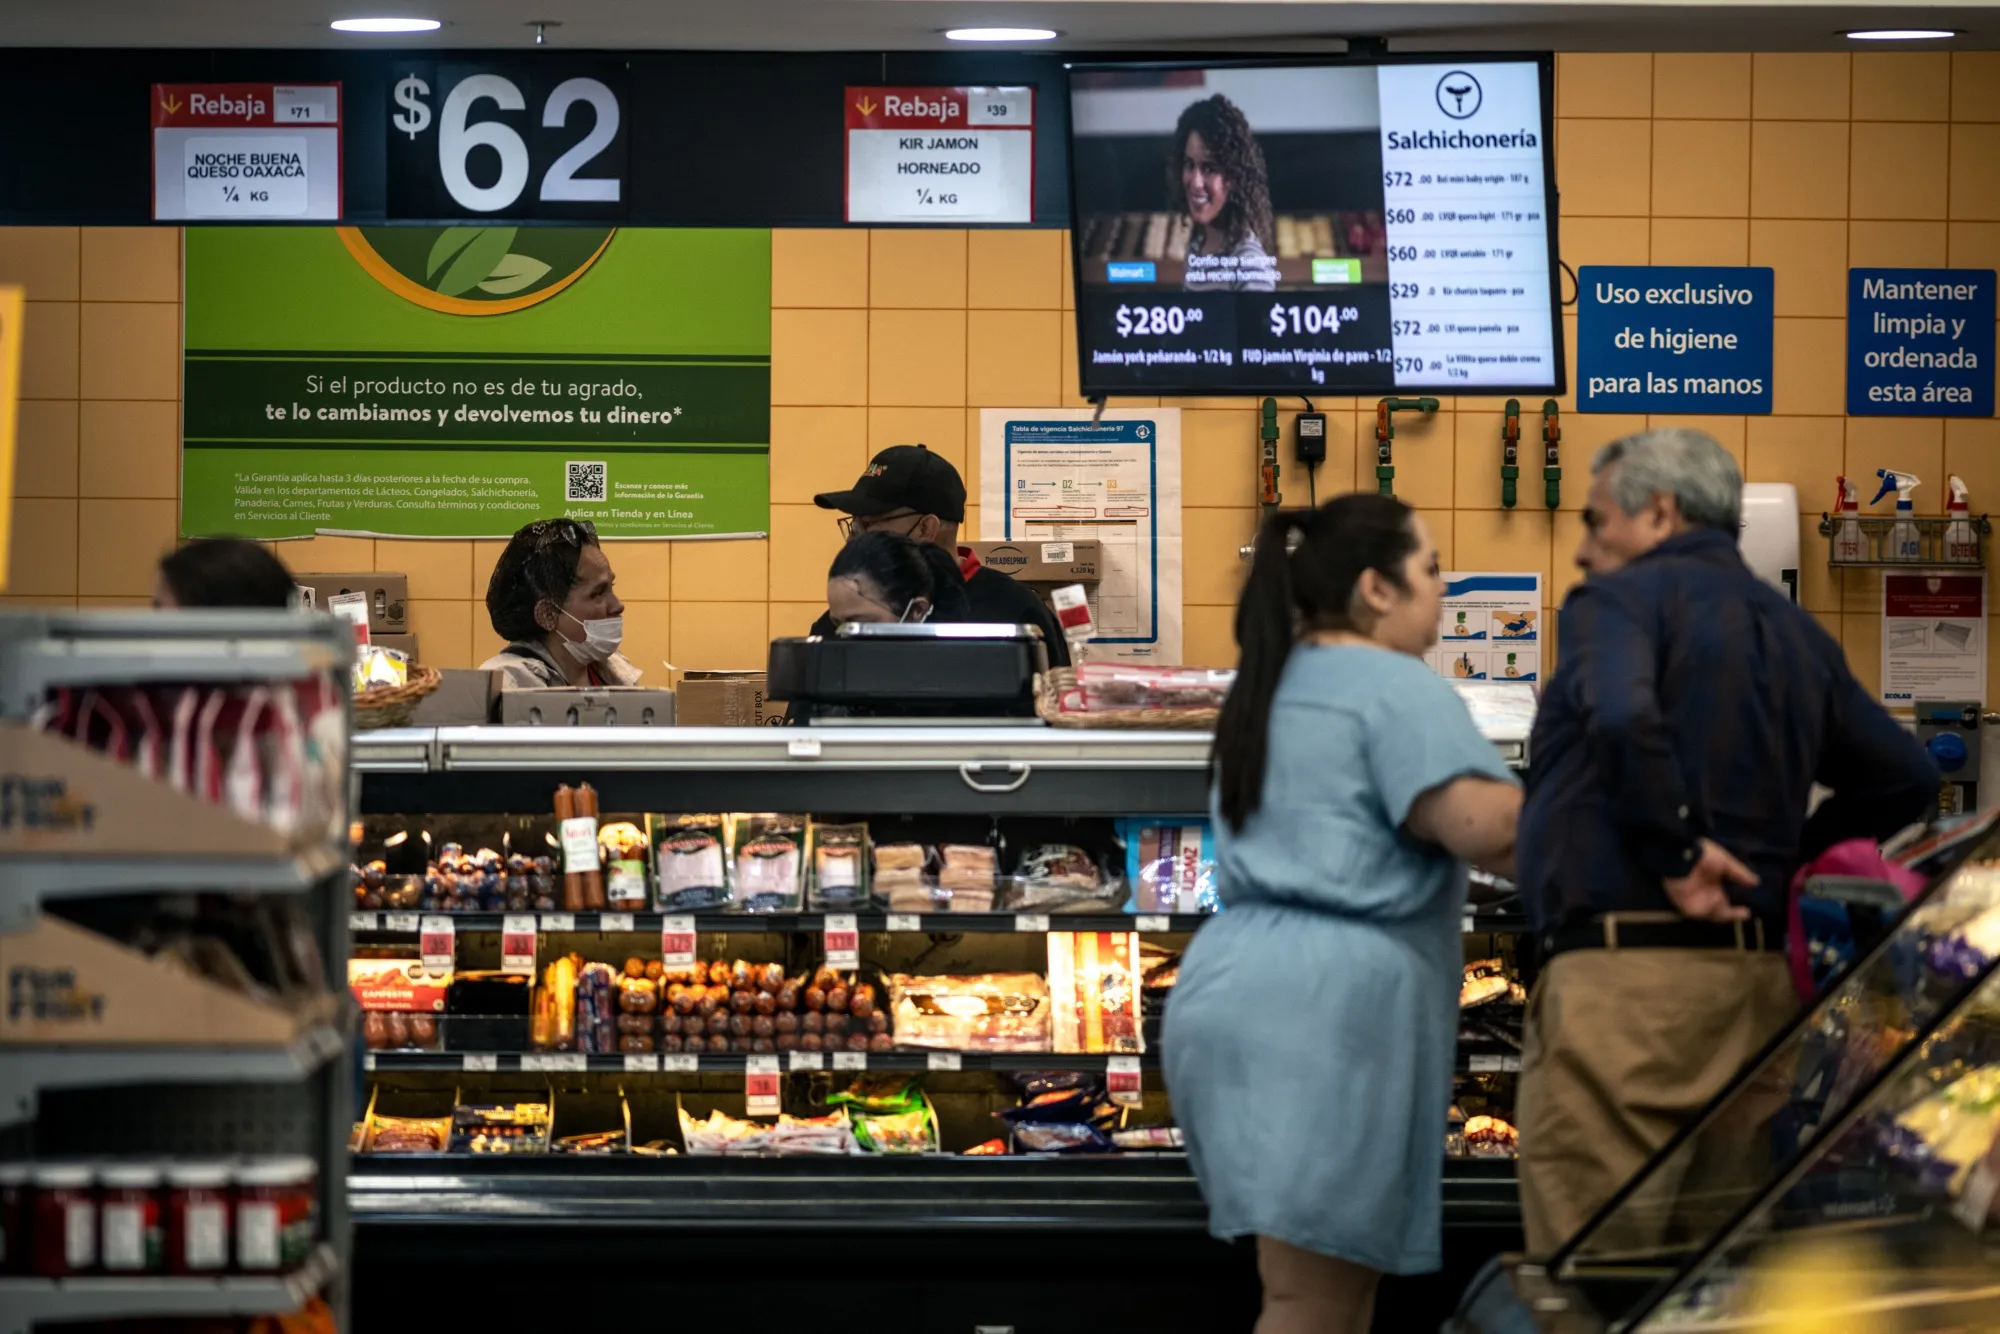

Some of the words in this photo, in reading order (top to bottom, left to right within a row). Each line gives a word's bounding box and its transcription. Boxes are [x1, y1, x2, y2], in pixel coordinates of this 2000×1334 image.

[190, 93, 265, 121] Rebaja
[291, 107, 310, 118] $71
[884, 95, 960, 123] Rebaja
[987, 105, 1007, 116] $39
[393, 73, 620, 212] $62
[899, 137, 923, 149] KIR
[927, 137, 979, 150] JAMON
[1388, 128, 1537, 150] Salchichonería
[195, 153, 246, 166] NOCHE
[250, 153, 301, 165] BUENA
[187, 166, 239, 179] QUESO
[243, 165, 305, 178] OAXACA
[897, 162, 981, 174] HORNEADO
[1385, 171, 1413, 188] $72
[250, 191, 269, 202] KG
[939, 194, 958, 204] KG
[1387, 208, 1415, 225] $60
[1389, 245, 1417, 262] $60
[1390, 283, 1419, 299] $29
[1596, 283, 1640, 304] Uso
[1644, 283, 1753, 305] exclusivo
[1862, 278, 1978, 301] Mantener
[1393, 320, 1421, 337] $72
[1873, 312, 1946, 338] limpia
[1951, 318, 1966, 340] y
[1614, 328, 1644, 349] de
[1650, 328, 1738, 354] higiene
[1093, 350, 1123, 363] Jamón
[1124, 350, 1146, 365] york
[1146, 350, 1196, 365] peñaranda
[1203, 350, 1219, 363] 1/2
[1220, 350, 1232, 366] kg
[1294, 349, 1331, 365] Virginia
[1332, 350, 1345, 363] de
[1346, 350, 1369, 365] pavo
[1376, 350, 1392, 362] 1/2
[1864, 347, 1978, 369] ordenada
[1395, 357, 1423, 374] $70
[1311, 367, 1324, 384] kg
[306, 375, 324, 394] Si
[330, 375, 346, 394] el
[354, 375, 446, 398] producto
[453, 380, 477, 395] no
[484, 380, 505, 396] es
[511, 376, 536, 396] de
[542, 379, 563, 396] tu
[568, 377, 643, 401] agrado,
[1589, 376, 1640, 398] para
[1647, 372, 1678, 394] las
[1683, 376, 1763, 395] manos
[1868, 383, 1917, 402] esta
[1922, 381, 1972, 403] área
[266, 405, 287, 420] te
[292, 403, 311, 420] lo
[316, 403, 432, 422] cambiamos
[437, 409, 450, 427] y
[454, 404, 574, 424] devolvemos
[580, 407, 601, 423] tu
[251, 473, 290, 483] Garantía
[291, 473, 318, 485] aplica
[319, 474, 343, 483] hasta
[345, 474, 350, 483] 3
[353, 474, 372, 483] días
[374, 474, 424, 486] posteriores
[425, 476, 431, 484] a
[432, 475, 441, 484] la
[442, 475, 467, 484] fecha
[468, 475, 480, 484] de
[482, 477, 493, 485] su
[494, 476, 531, 487] compra.
[674, 482, 689, 490] más
[1018, 480, 1025, 489] 01
[1062, 480, 1073, 489] 02
[234, 485, 262, 495] Válida
[263, 487, 275, 495] en
[277, 486, 290, 495] los
[291, 486, 361, 498] departamentos
[362, 487, 374, 496] de
[376, 486, 412, 497] Lácteos,
[413, 487, 469, 498] Congelados,
[470, 487, 539, 499] Salchichonería,
[656, 491, 666, 499] de
[667, 491, 673, 499] la
[234, 498, 281, 509] Panadería,
[283, 498, 315, 509] Carnes,
[317, 498, 345, 508] Frutas
[346, 501, 352, 510] y
[354, 499, 395, 509] Verduras.
[396, 500, 436, 509] Consulta
[437, 500, 478, 510] términos
[479, 502, 485, 511] y
[486, 500, 541, 510] condiciones
[234, 512, 246, 520] en
[247, 511, 287, 520] Servicios
[289, 511, 298, 520] al
[299, 511, 332, 521] Cliente.
[564, 508, 595, 521] Aplica
[611, 508, 643, 519] Tienda
[645, 511, 650, 520] y
[653, 511, 665, 519] en
[667, 508, 694, 519] Línea
[985, 556, 1028, 565] PHILADELPHIA
[755, 690, 763, 708] BOX
